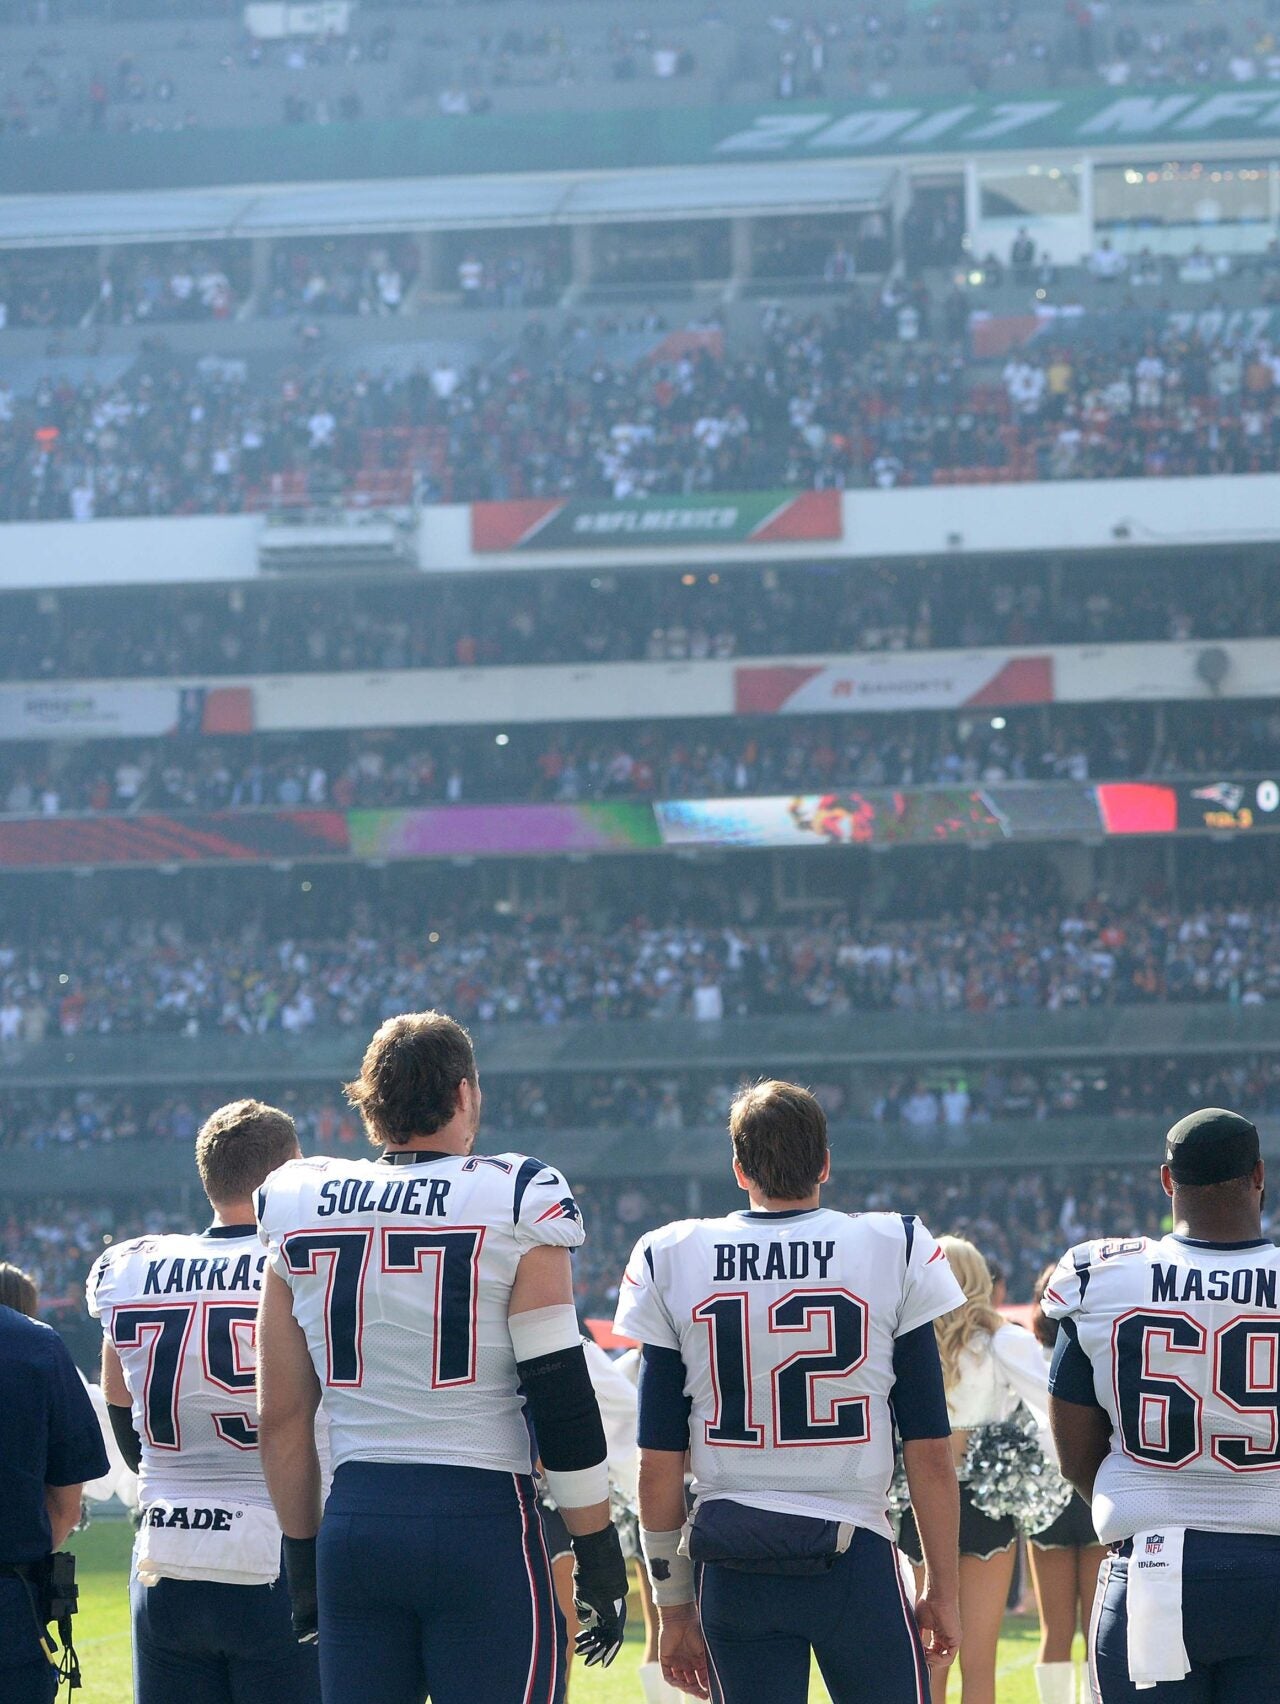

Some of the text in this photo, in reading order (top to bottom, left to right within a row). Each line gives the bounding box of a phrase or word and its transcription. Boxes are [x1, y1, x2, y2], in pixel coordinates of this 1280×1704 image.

[714, 102, 1062, 150] 2017
[1256, 779, 1280, 813] 0
[317, 1177, 452, 1218] SOLDER
[713, 1240, 836, 1282] BRADY
[280, 1225, 487, 1389] 77
[1151, 1263, 1278, 1309] MASON
[692, 1287, 871, 1449] 12
[1138, 1561, 1166, 1569] Wilson
[1146, 1543, 1162, 1555] NFL
